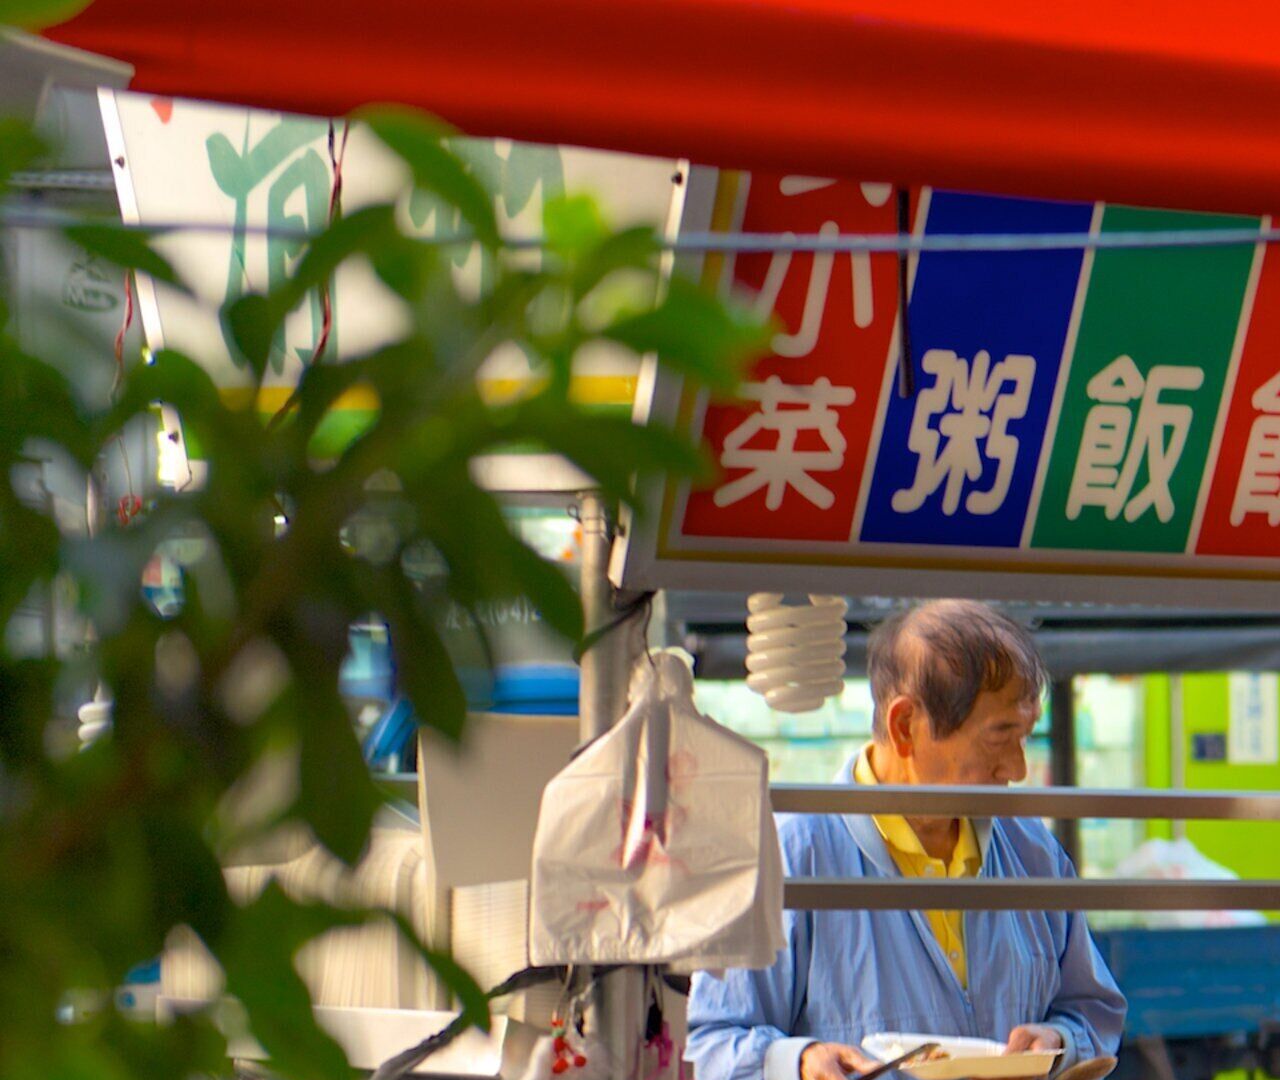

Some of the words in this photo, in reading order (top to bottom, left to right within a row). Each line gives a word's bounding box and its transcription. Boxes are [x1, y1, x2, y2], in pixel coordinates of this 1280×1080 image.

[713, 175, 894, 511] 小菜
[891, 348, 1037, 516] 粥
[1065, 354, 1205, 524] 飯
